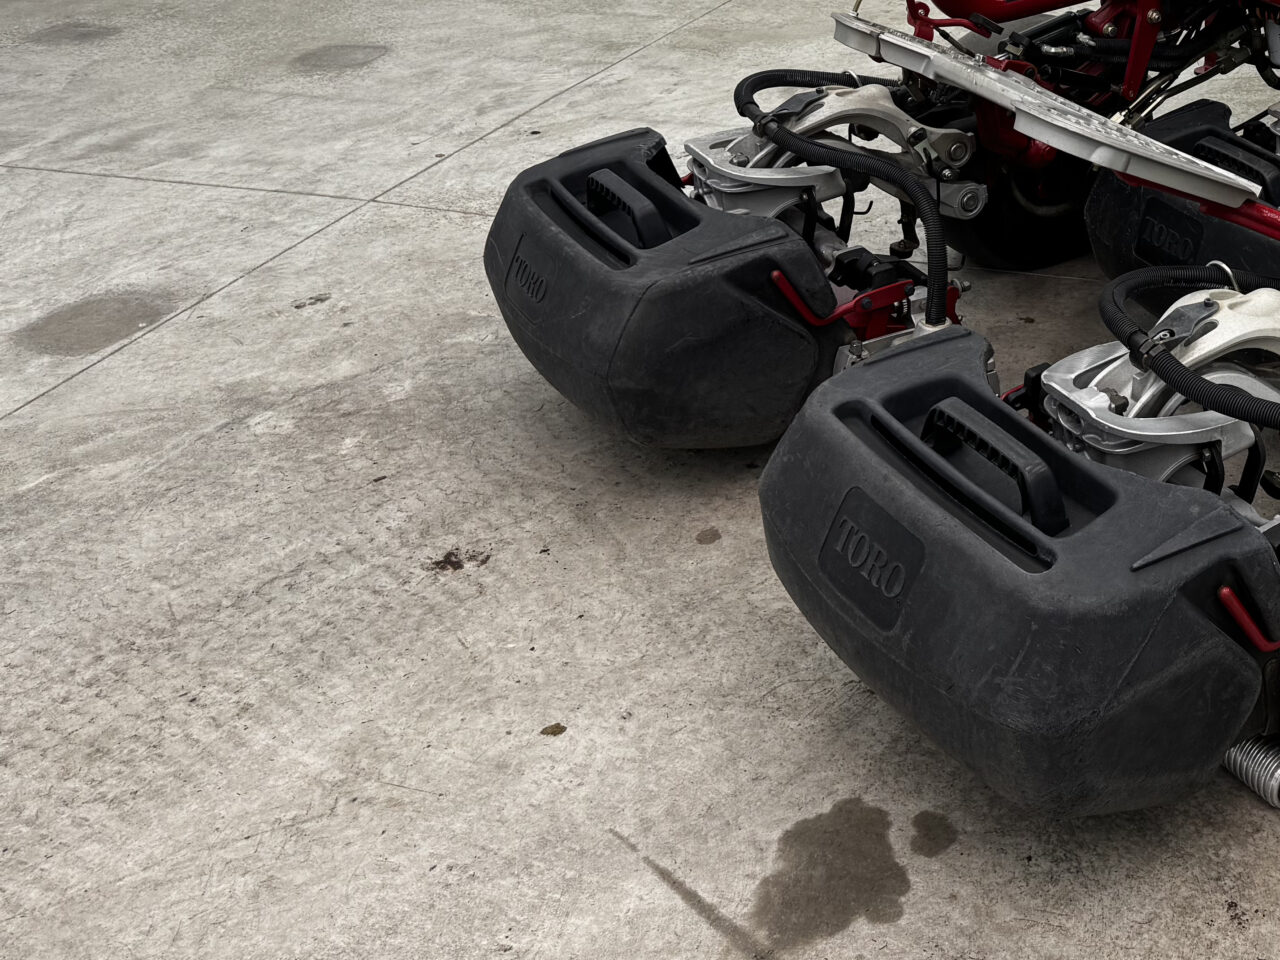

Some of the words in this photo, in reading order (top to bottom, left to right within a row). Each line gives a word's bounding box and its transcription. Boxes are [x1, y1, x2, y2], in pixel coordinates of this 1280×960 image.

[1140, 216, 1194, 261] TORO
[515, 254, 548, 304] TORO
[834, 516, 906, 598] TORO
